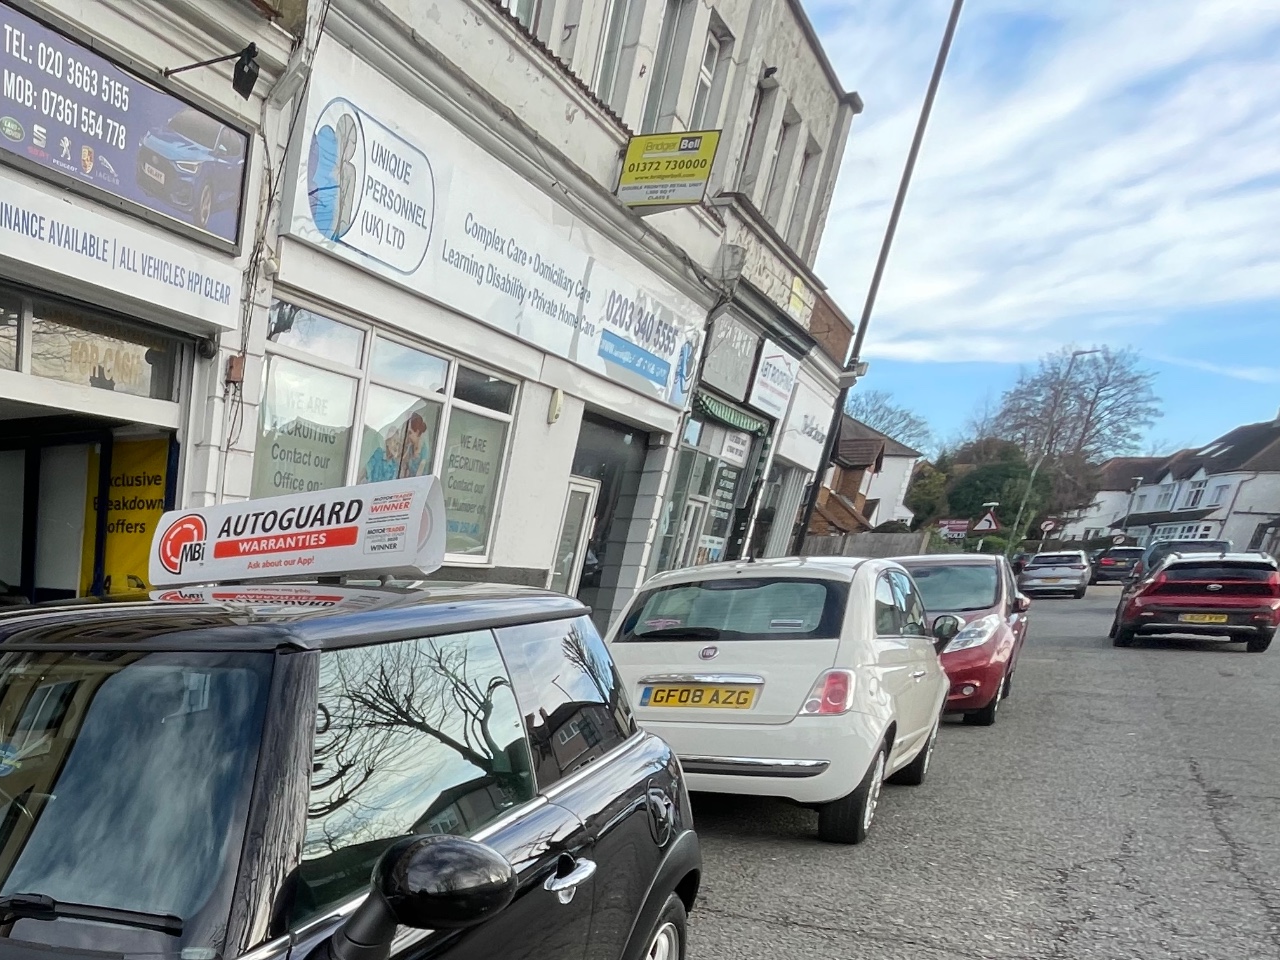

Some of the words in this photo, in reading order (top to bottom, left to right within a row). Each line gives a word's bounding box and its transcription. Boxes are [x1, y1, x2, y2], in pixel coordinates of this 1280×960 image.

[4, 24, 33, 65] TEL:
[37, 43, 63, 80] 020
[67, 60, 99, 96] 3663
[102, 78, 130, 113] 5155
[3, 69, 38, 111] MOB:
[41, 88, 78, 129] 07361
[81, 112, 104, 140] 554
[106, 118, 126, 150] 778
[681, 139, 700, 150] Bell
[52, 158, 79, 173] PEUGEOT
[371, 140, 413, 186] UNIQUE
[628, 161, 661, 173] 01372
[665, 158, 708, 171] 730000
[366, 175, 428, 231] PERSONNEL
[360, 215, 384, 247] (UK)
[385, 223, 406, 251] LTD
[48, 219, 109, 263] AVAILABLE
[120, 246, 138, 274] ALL
[141, 253, 185, 289] VEHICLES
[188, 269, 202, 296] HPI
[204, 275, 232, 306] CLEAR
[464, 213, 506, 255] Complex
[506, 237, 528, 266] Care
[532, 248, 575, 295] Domiciliary
[574, 276, 591, 304] Care
[442, 239, 485, 284] Learning
[486, 262, 528, 302] Disability
[532, 289, 557, 319] Private
[558, 302, 578, 328] Home
[579, 312, 595, 337] Care
[606, 290, 635, 332] 0203
[634, 306, 655, 343] 340
[71, 341, 99, 378] FOR
[460, 433, 472, 449] WE
[472, 437, 487, 453] ARE
[271, 443, 311, 464] Contact
[313, 454, 331, 469] our
[448, 453, 490, 475] RECRUITING
[107, 472, 162, 487] xclusive
[273, 470, 304, 490] Office
[447, 475, 473, 493] Contact
[93, 496, 165, 511] Beakdown
[370, 501, 410, 513] WINNER
[107, 519, 146, 534] offers
[217, 498, 364, 539] AUTOGUARD
[238, 532, 327, 553] WARRANTIES
[370, 542, 397, 552] WINNER
[247, 558, 261, 570] Ask
[262, 557, 283, 569] about
[283, 559, 297, 568] our
[298, 554, 315, 568] App!
[653, 688, 704, 704] GF08
[708, 689, 751, 706] AZG
